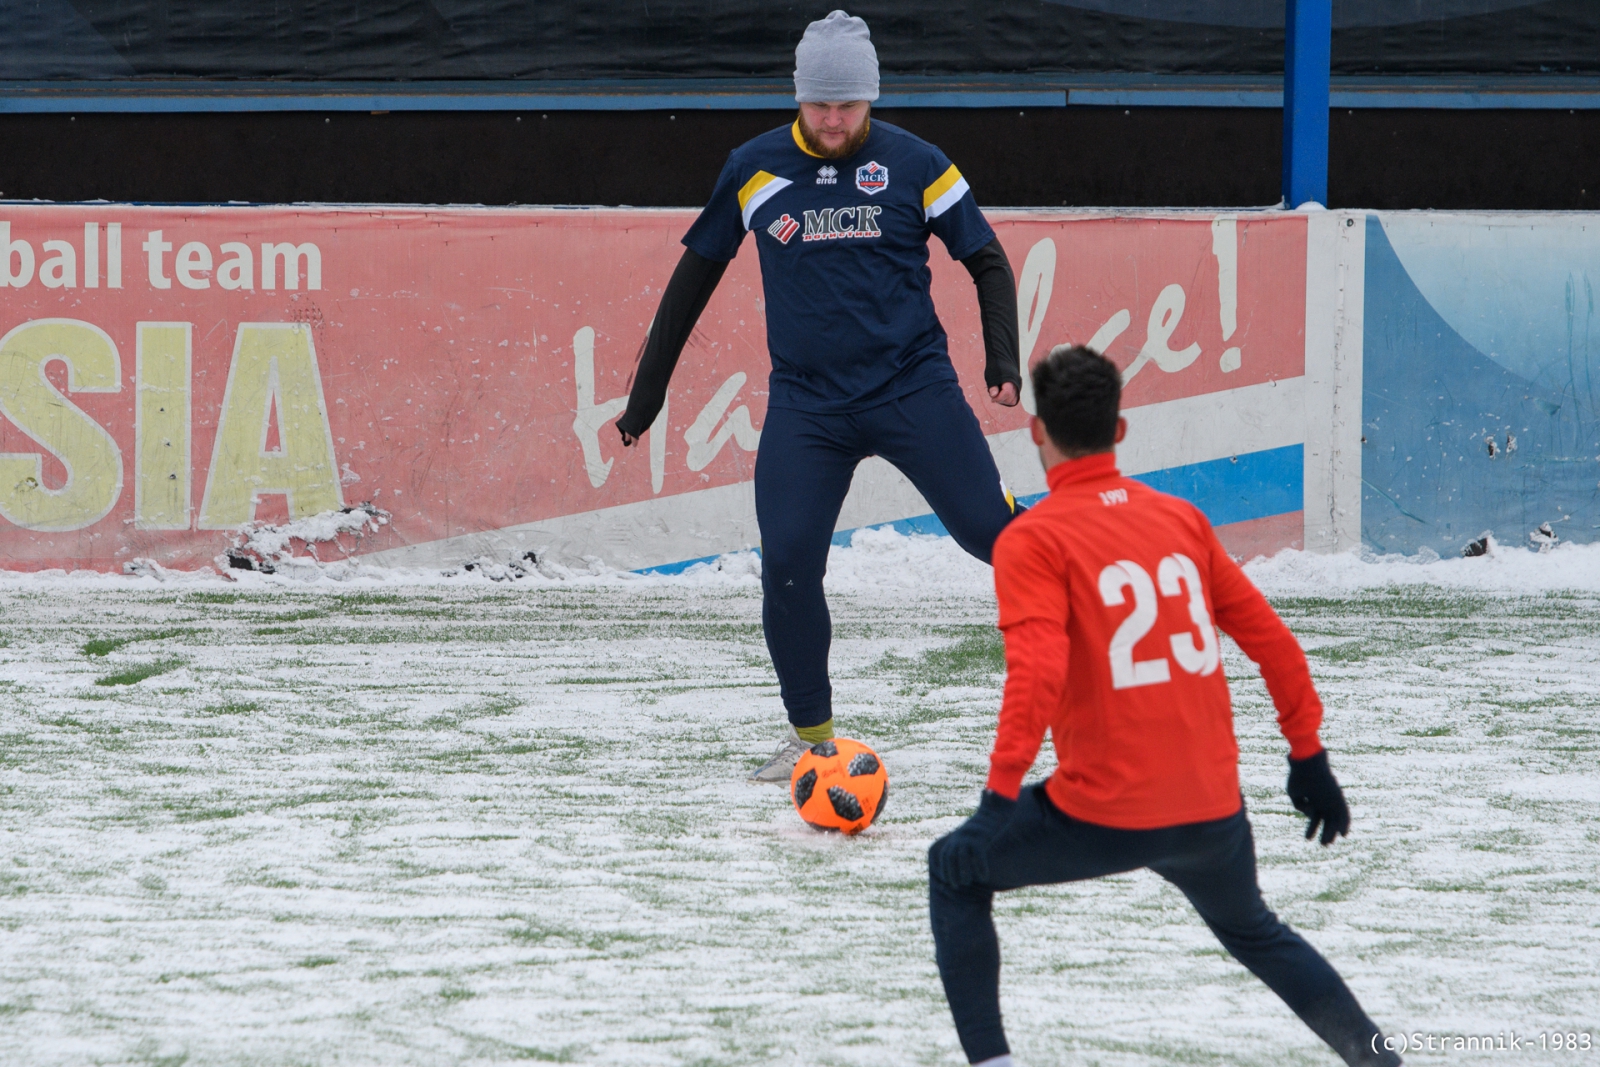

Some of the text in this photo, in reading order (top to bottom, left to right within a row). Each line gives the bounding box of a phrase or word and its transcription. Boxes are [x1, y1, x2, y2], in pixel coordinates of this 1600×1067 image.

[803, 205, 882, 235] МСК
[142, 229, 322, 290] team
[1098, 488, 1128, 506] 1997
[1097, 552, 1220, 690] 23
